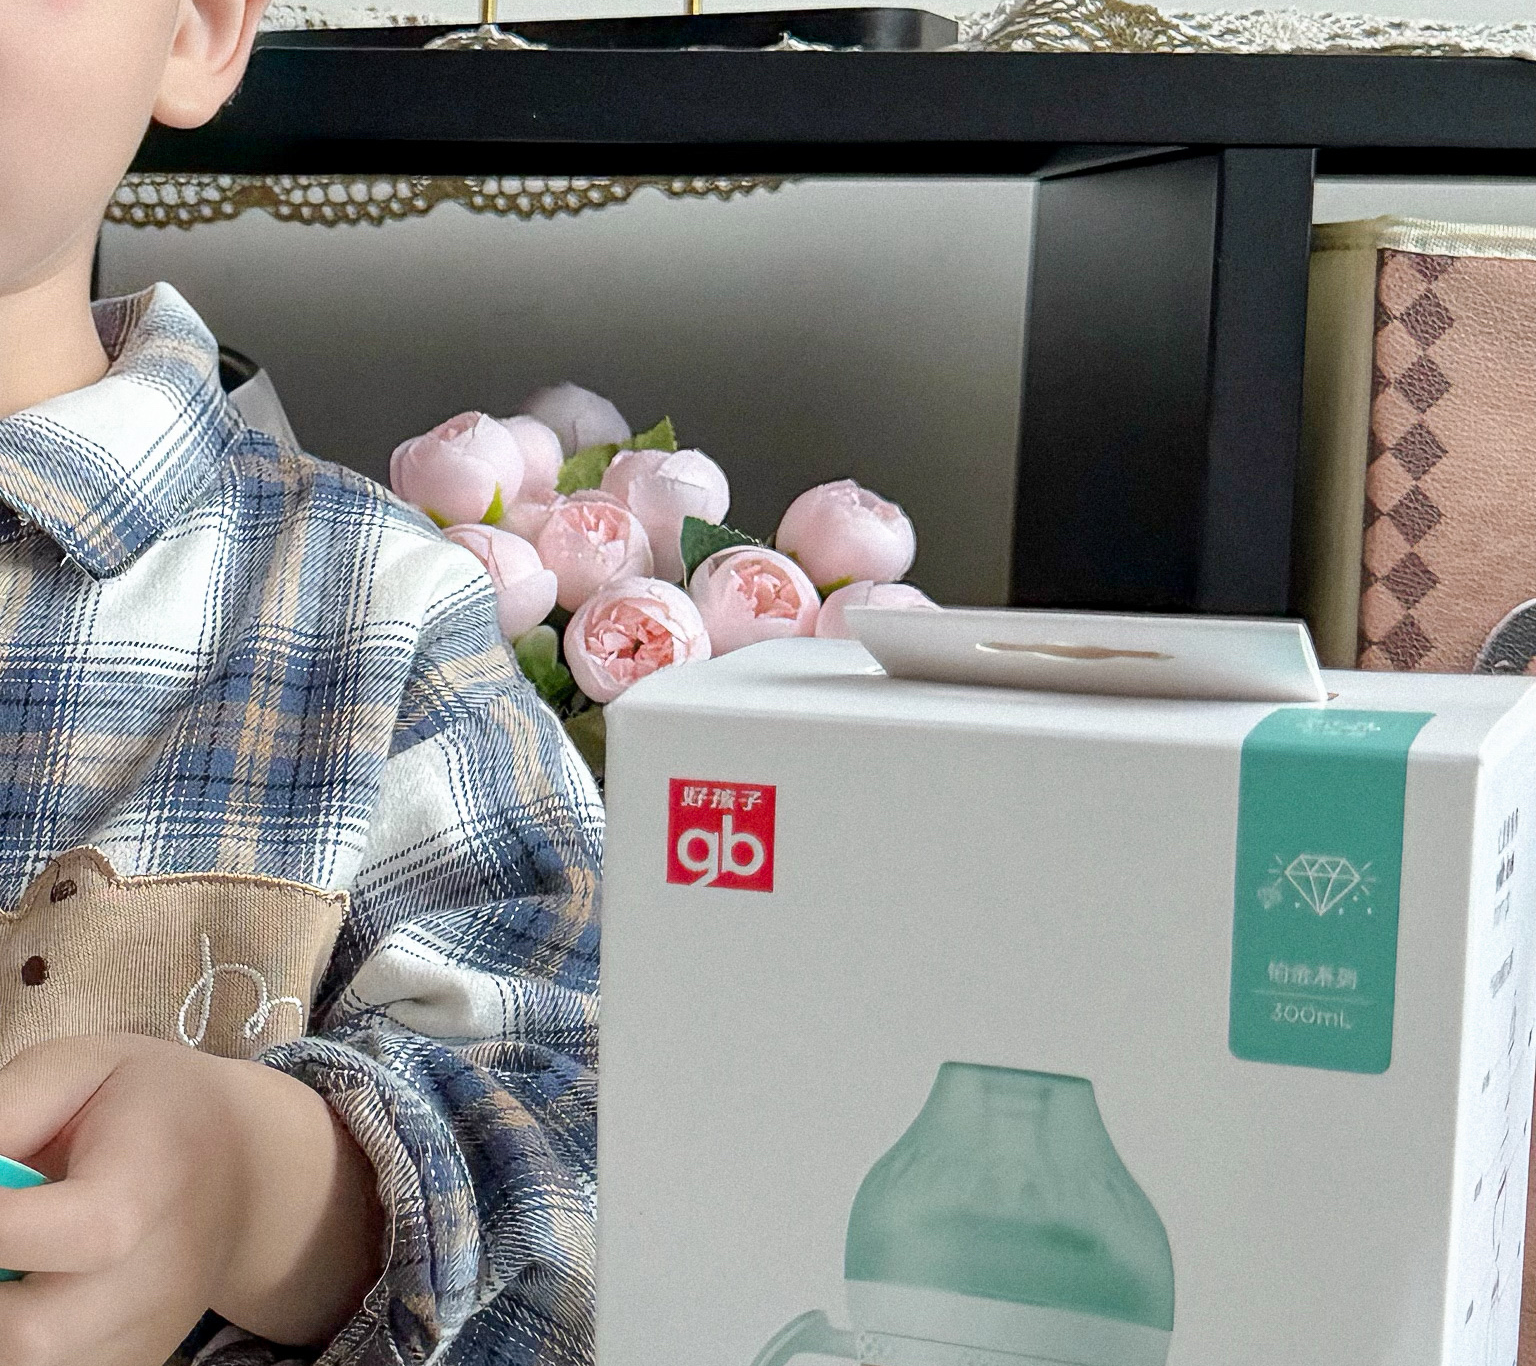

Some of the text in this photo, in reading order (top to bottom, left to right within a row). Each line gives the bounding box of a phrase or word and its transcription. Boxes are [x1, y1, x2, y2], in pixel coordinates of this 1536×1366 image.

[681, 786, 763, 811] 好孩子
[677, 814, 765, 887] gb
[1272, 1002, 1352, 1030] 300mL
